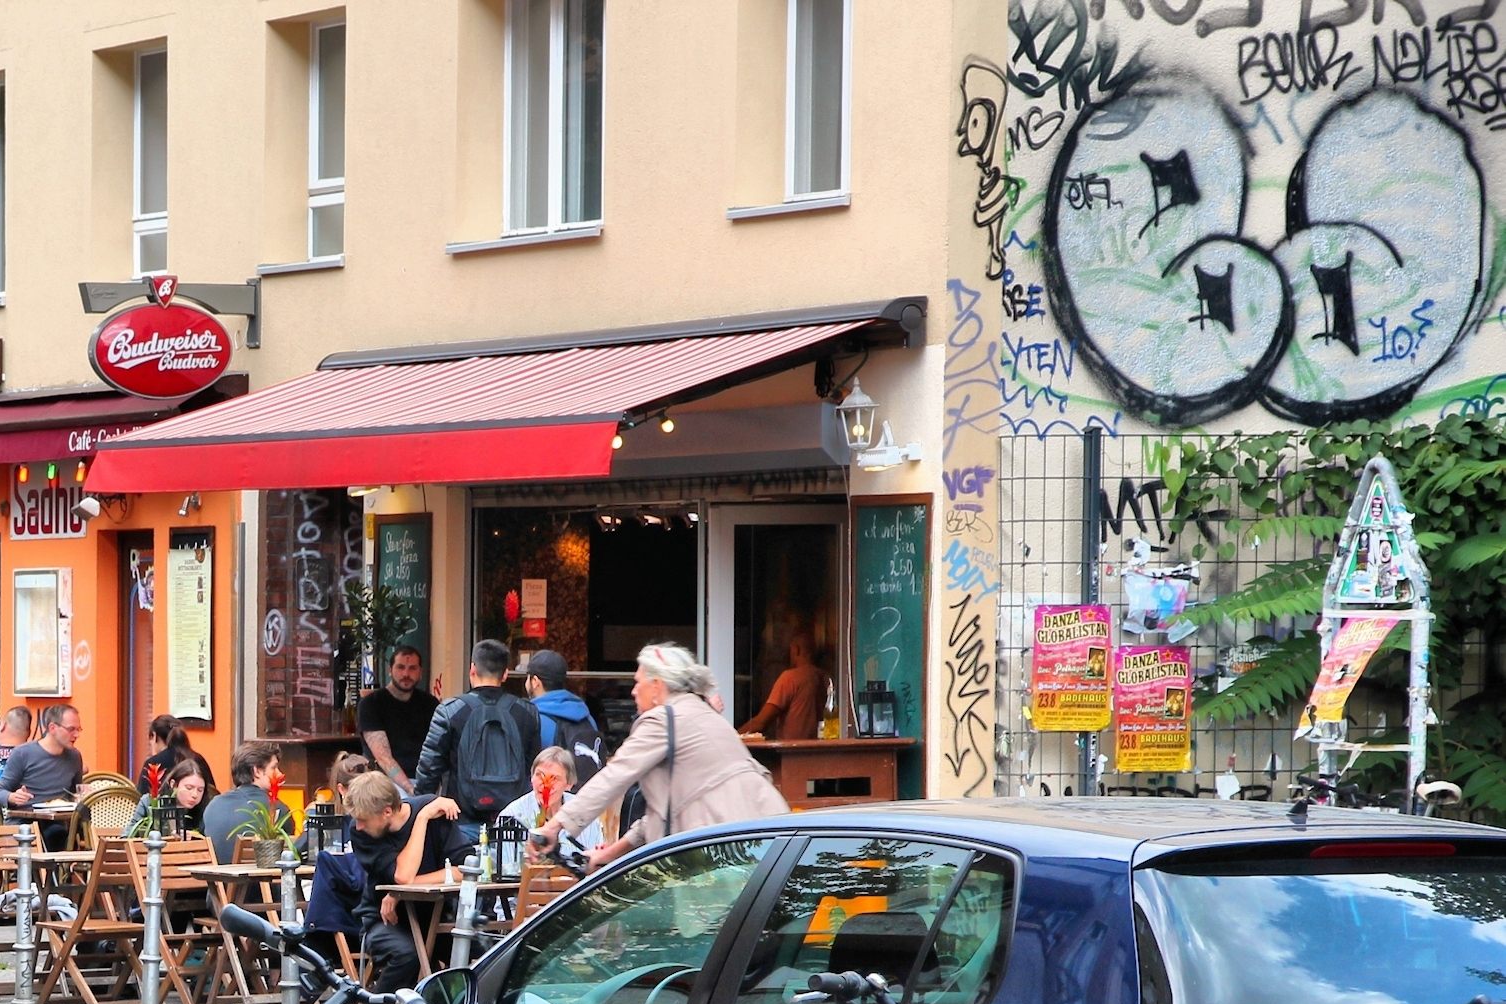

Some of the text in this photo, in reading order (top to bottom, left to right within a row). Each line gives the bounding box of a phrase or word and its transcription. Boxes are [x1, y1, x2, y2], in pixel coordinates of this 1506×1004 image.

[107, 328, 222, 366] Budweiser
[158, 350, 220, 371] Budvar
[13, 465, 84, 535] Sadhu
[1044, 610, 1081, 629] DANZA
[1037, 622, 1107, 644] GLOBALISTAN
[1124, 651, 1160, 670] DANZA
[1117, 663, 1187, 685] GLOBALISTAN
[1060, 693, 1107, 703] BADEHAUS
[1140, 734, 1185, 744] BADEHAUS
